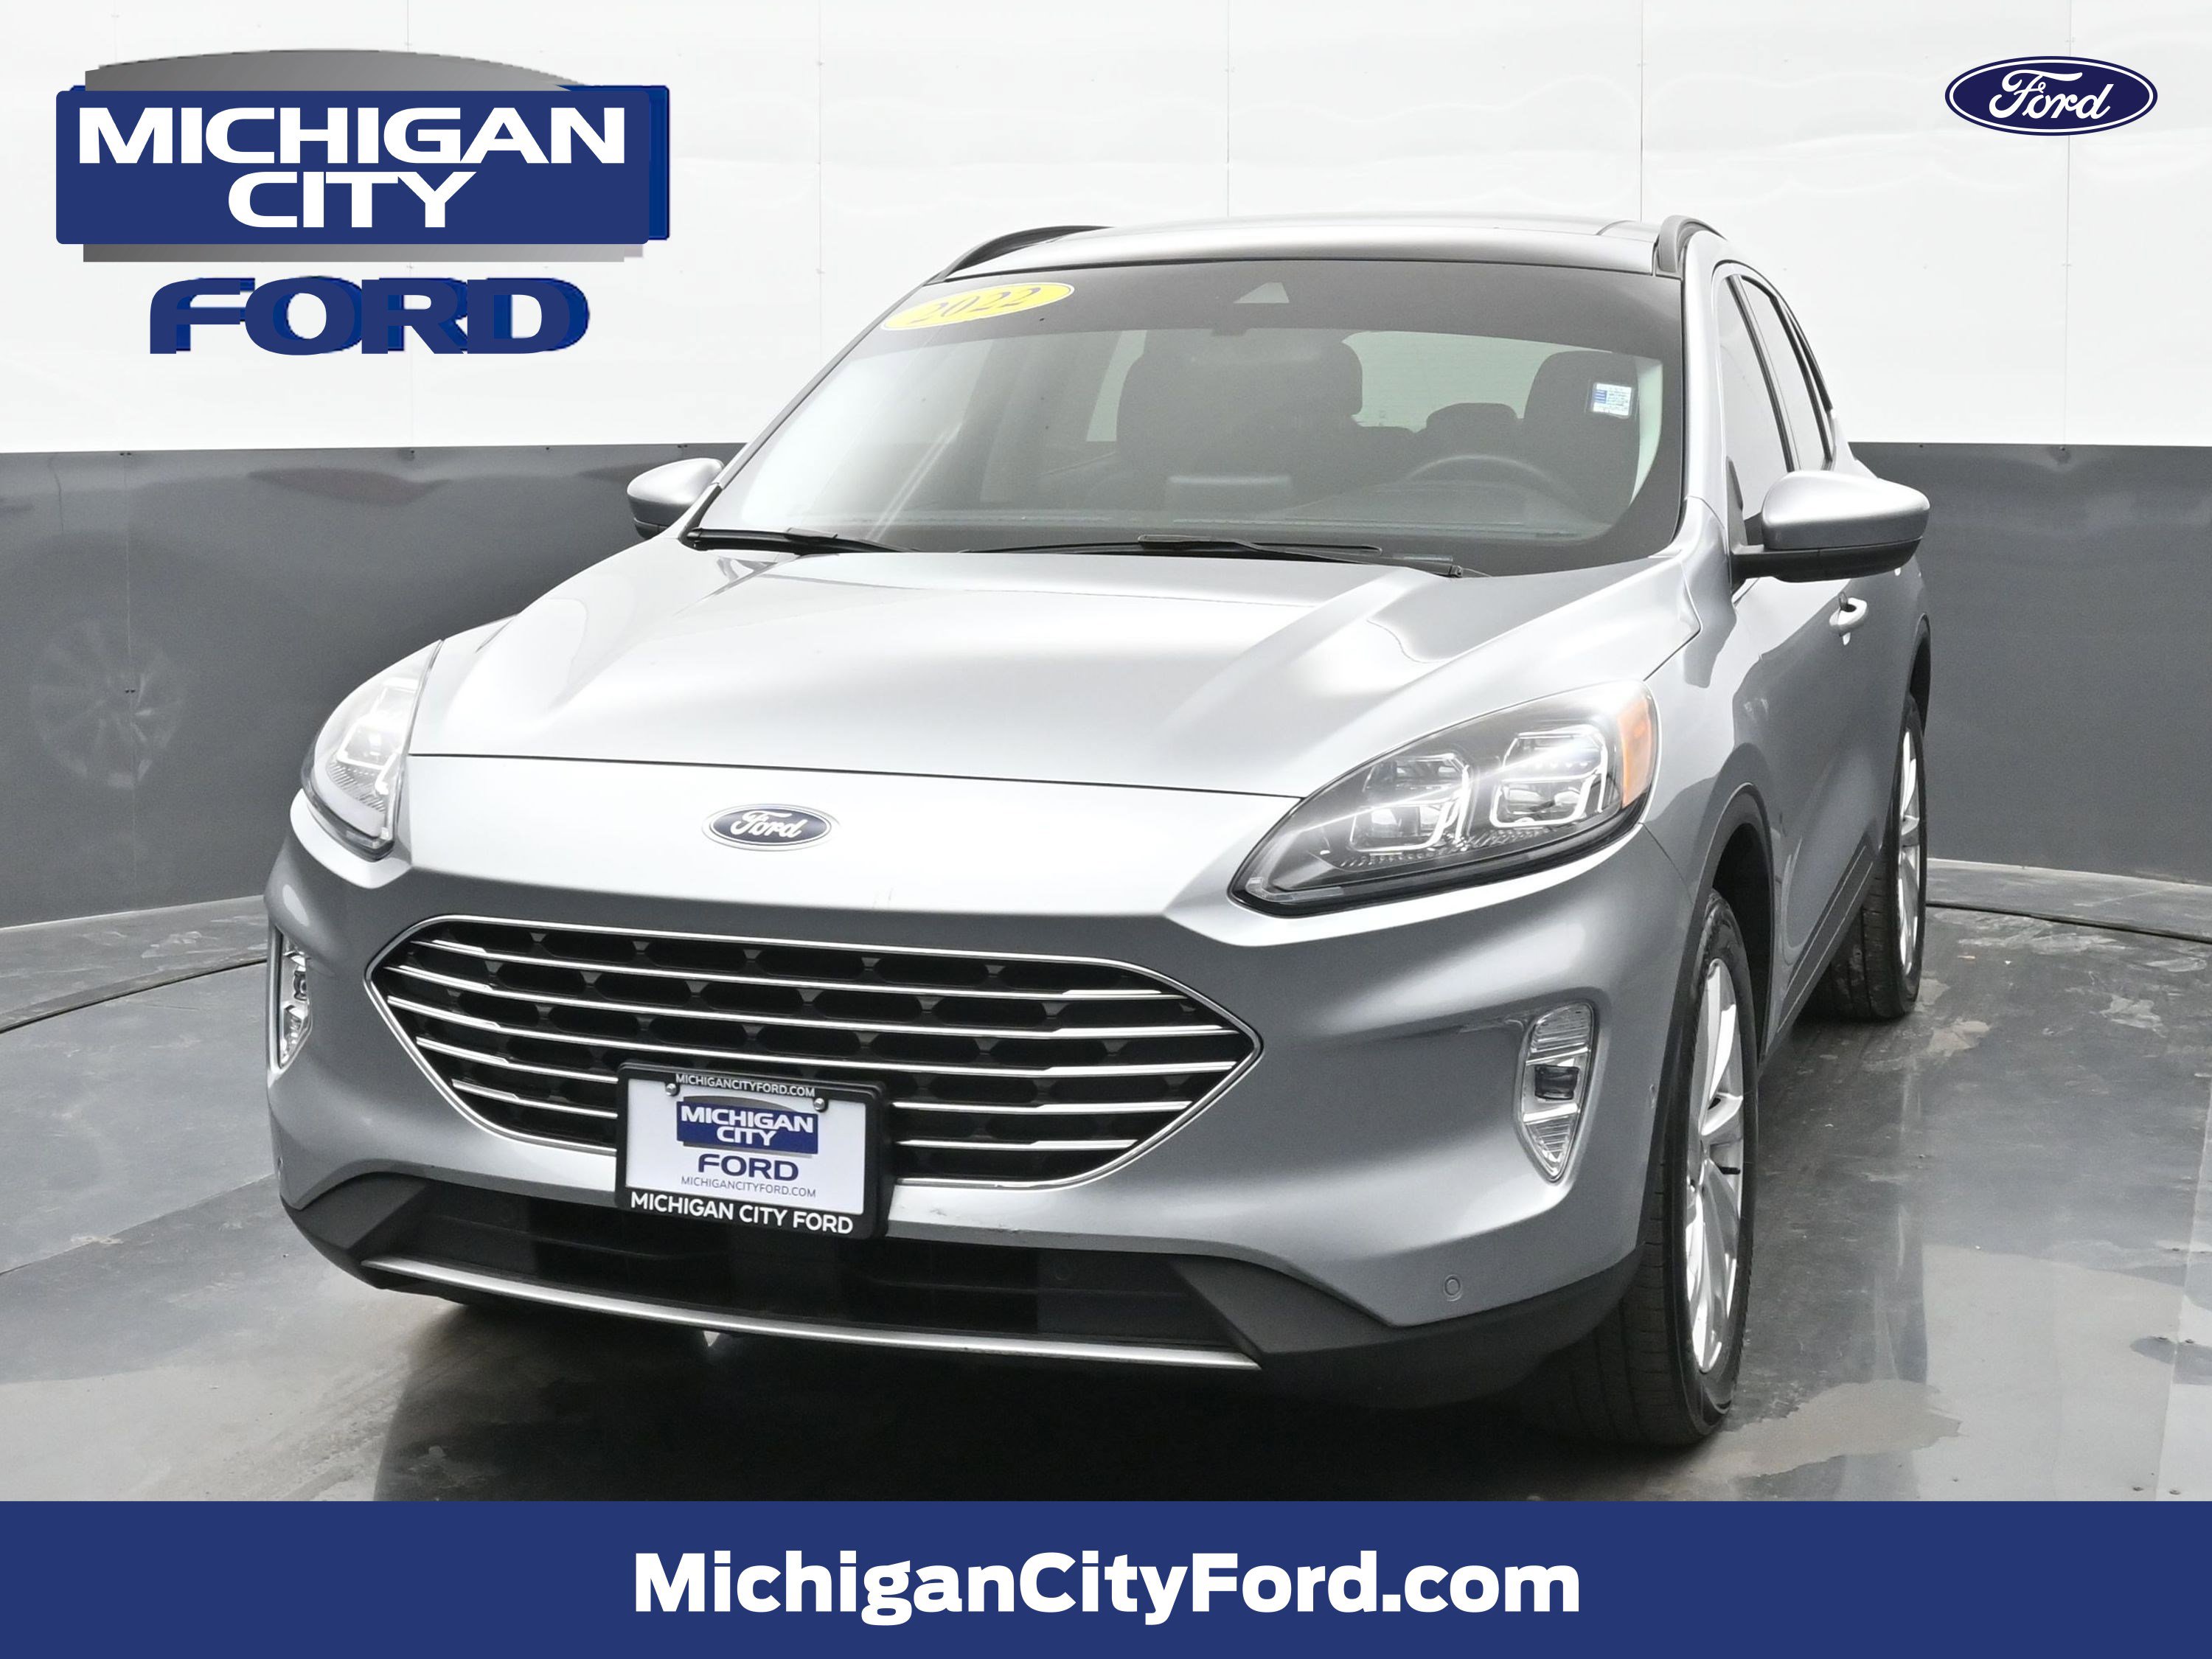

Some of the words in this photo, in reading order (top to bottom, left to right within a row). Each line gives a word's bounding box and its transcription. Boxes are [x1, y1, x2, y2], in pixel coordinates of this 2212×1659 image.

[905, 285, 1042, 325] 2022
[730, 810, 808, 838] Ford
[675, 1073, 815, 1098] MICHIGANCITYFORD.COM
[680, 1105, 814, 1133] MICHIGAN
[716, 1126, 777, 1146] CITY
[698, 1153, 799, 1181] FORD
[681, 1175, 816, 1198] MICHIGANCITYFORD.COM
[630, 1191, 734, 1220] MICHIGAN
[739, 1205, 787, 1227] CITY
[793, 1214, 854, 1234] FORD
